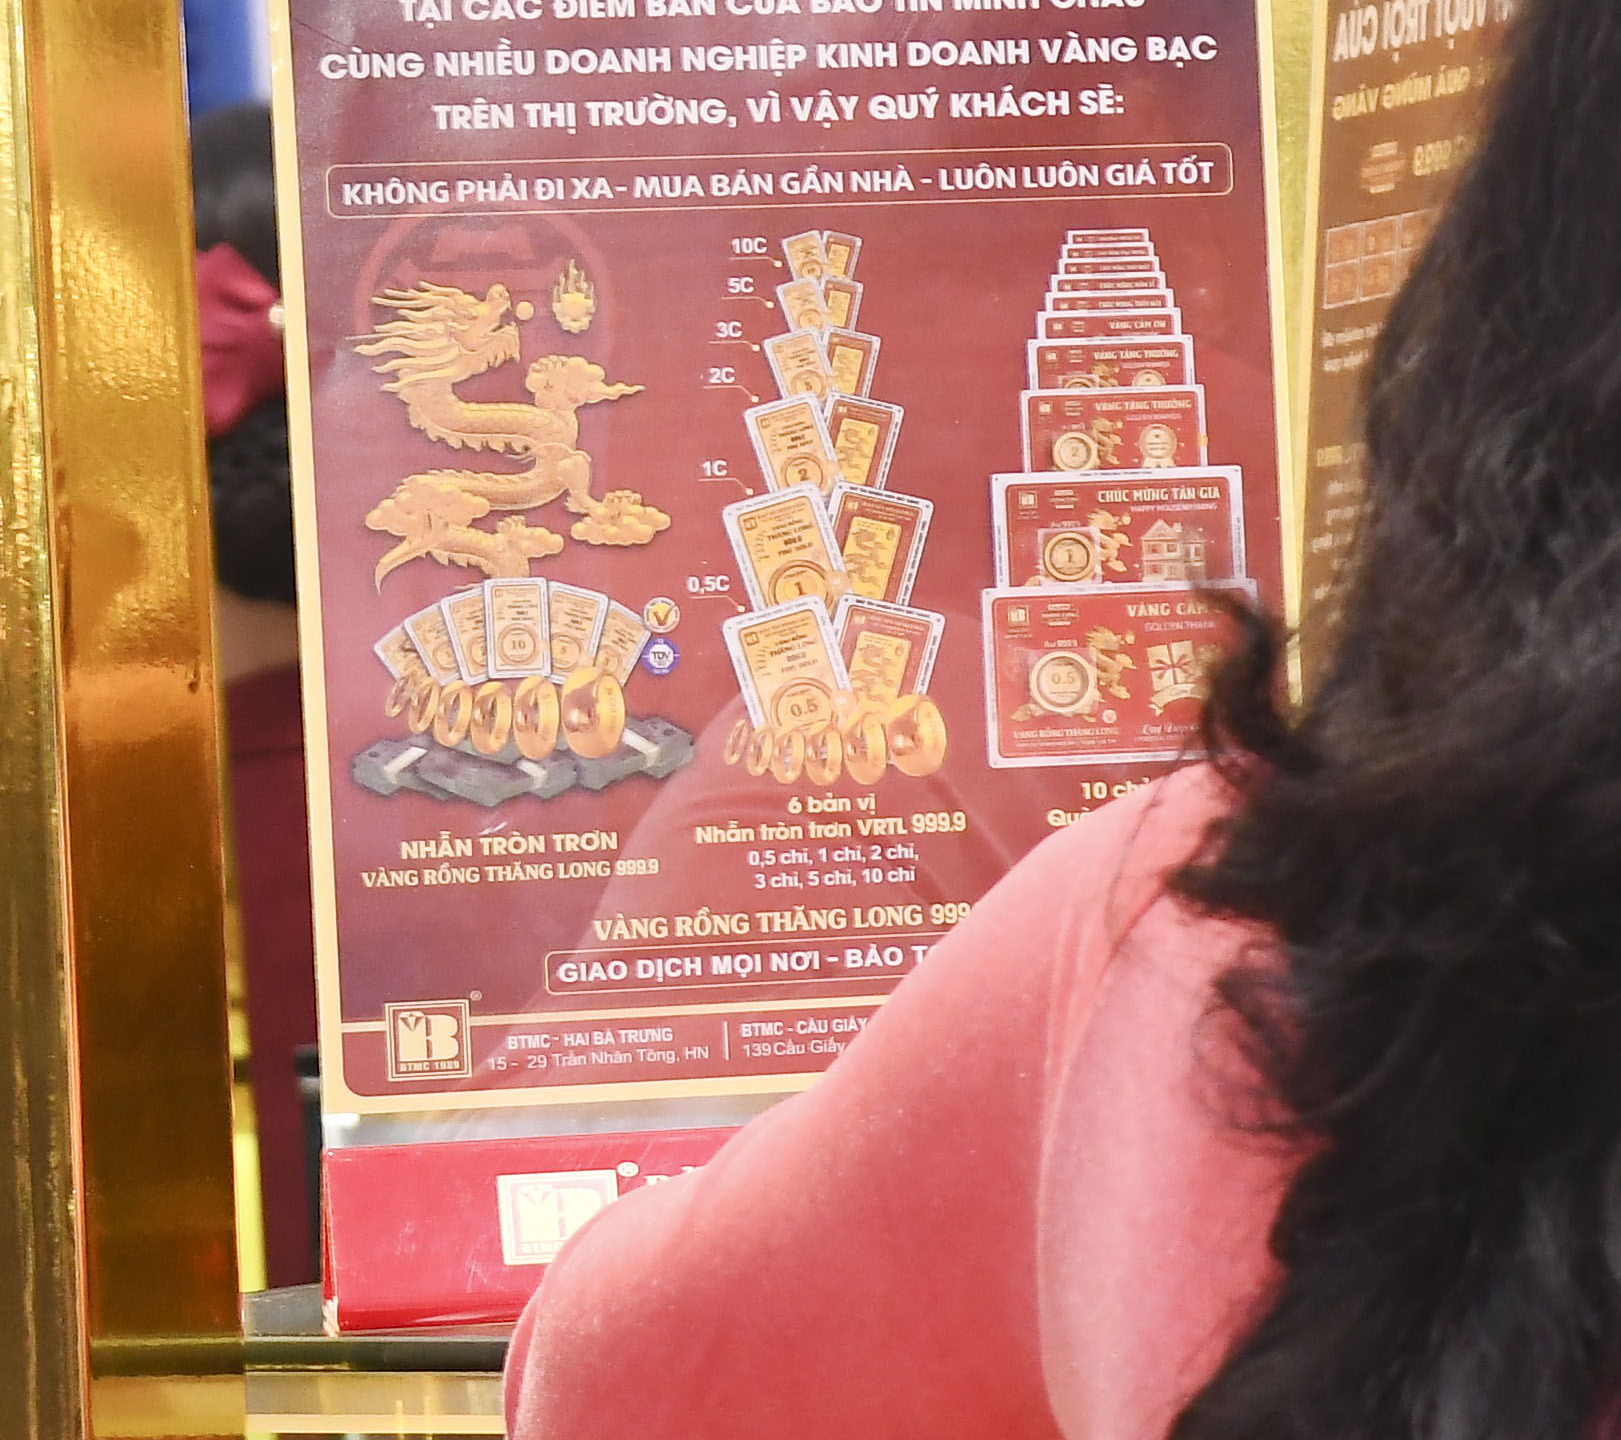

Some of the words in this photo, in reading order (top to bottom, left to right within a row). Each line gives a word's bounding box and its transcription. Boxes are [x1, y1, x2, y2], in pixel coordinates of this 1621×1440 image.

[318, 45, 425, 80] CÙNG
[433, 36, 535, 78] NHIỀU
[544, 46, 672, 75] DOANH
[680, 36, 808, 77] NGHIỆP
[815, 41, 898, 69] KINH
[906, 38, 1030, 67] DOANH
[1038, 30, 1138, 64] VÀNG
[1146, 34, 1218, 68] BẠC
[431, 96, 515, 131] TRÊN
[521, 101, 577, 135] THỊ
[583, 91, 737, 128] TRƯỜNG,
[745, 89, 781, 123] VÌ
[789, 88, 859, 129] VẬY
[867, 85, 940, 120] QUÝ
[949, 83, 1070, 118] KHÁCH
[1078, 82, 1125, 115] SẼ:
[342, 176, 450, 206] KHÔNG
[455, 171, 528, 203] PHẢI
[533, 177, 565, 201] ĐI
[632, 174, 705, 199] MUA
[710, 167, 774, 197] BÁN
[779, 163, 844, 195] GẦN
[849, 163, 915, 193] NHÀ
[938, 161, 1017, 191] LUÔN
[1022, 160, 1099, 188] LUÔN
[1105, 157, 1157, 186] GIÁ
[1160, 153, 1215, 185] TỐT
[731, 237, 769, 254] 10C
[727, 276, 755, 293] 5C
[715, 321, 742, 338] 3C
[709, 366, 736, 383] 2C
[702, 459, 728, 476] 1C
[687, 575, 731, 594] 0,5C
[788, 796, 802, 813] 6
[807, 792, 851, 813] bản
[856, 793, 875, 815] vị
[694, 819, 755, 844] Nhẫn
[758, 820, 803, 841] tròn
[807, 820, 852, 839] trơn
[857, 817, 907, 836] VRTL
[911, 810, 967, 834] 999.9
[400, 829, 473, 860] NHẪN
[479, 831, 546, 857] TRÒN
[551, 828, 618, 853] TRƠN
[749, 850, 776, 867] 0,5
[817, 846, 827, 863] 1
[869, 843, 882, 861] 2
[360, 865, 419, 888] VÀNG
[422, 861, 480, 885] RỒNG
[483, 859, 554, 882] THĂNG
[556, 859, 611, 879] LONG
[614, 857, 659, 877] 999.9
[754, 872, 766, 889] 3
[807, 869, 820, 887] 5
[862, 868, 883, 884] 10
[592, 912, 669, 942] VÀNG
[674, 905, 750, 937] RỒNG
[755, 904, 847, 933] THĂNG
[852, 903, 923, 929] LONG
[556, 959, 628, 983] GIAO
[634, 955, 702, 983] DỊCH
[710, 952, 762, 979] MỌI
[769, 949, 820, 972] NƠI
[843, 942, 904, 969] BẢO
[506, 1032, 551, 1050] BTMC
[562, 1031, 590, 1047] HAI
[592, 1026, 616, 1046] BÀ
[617, 1026, 673, 1044] TRƯNG
[525, 1053, 548, 1069] 29
[589, 1049, 633, 1065] Nhân
[684, 1044, 709, 1060] HN
